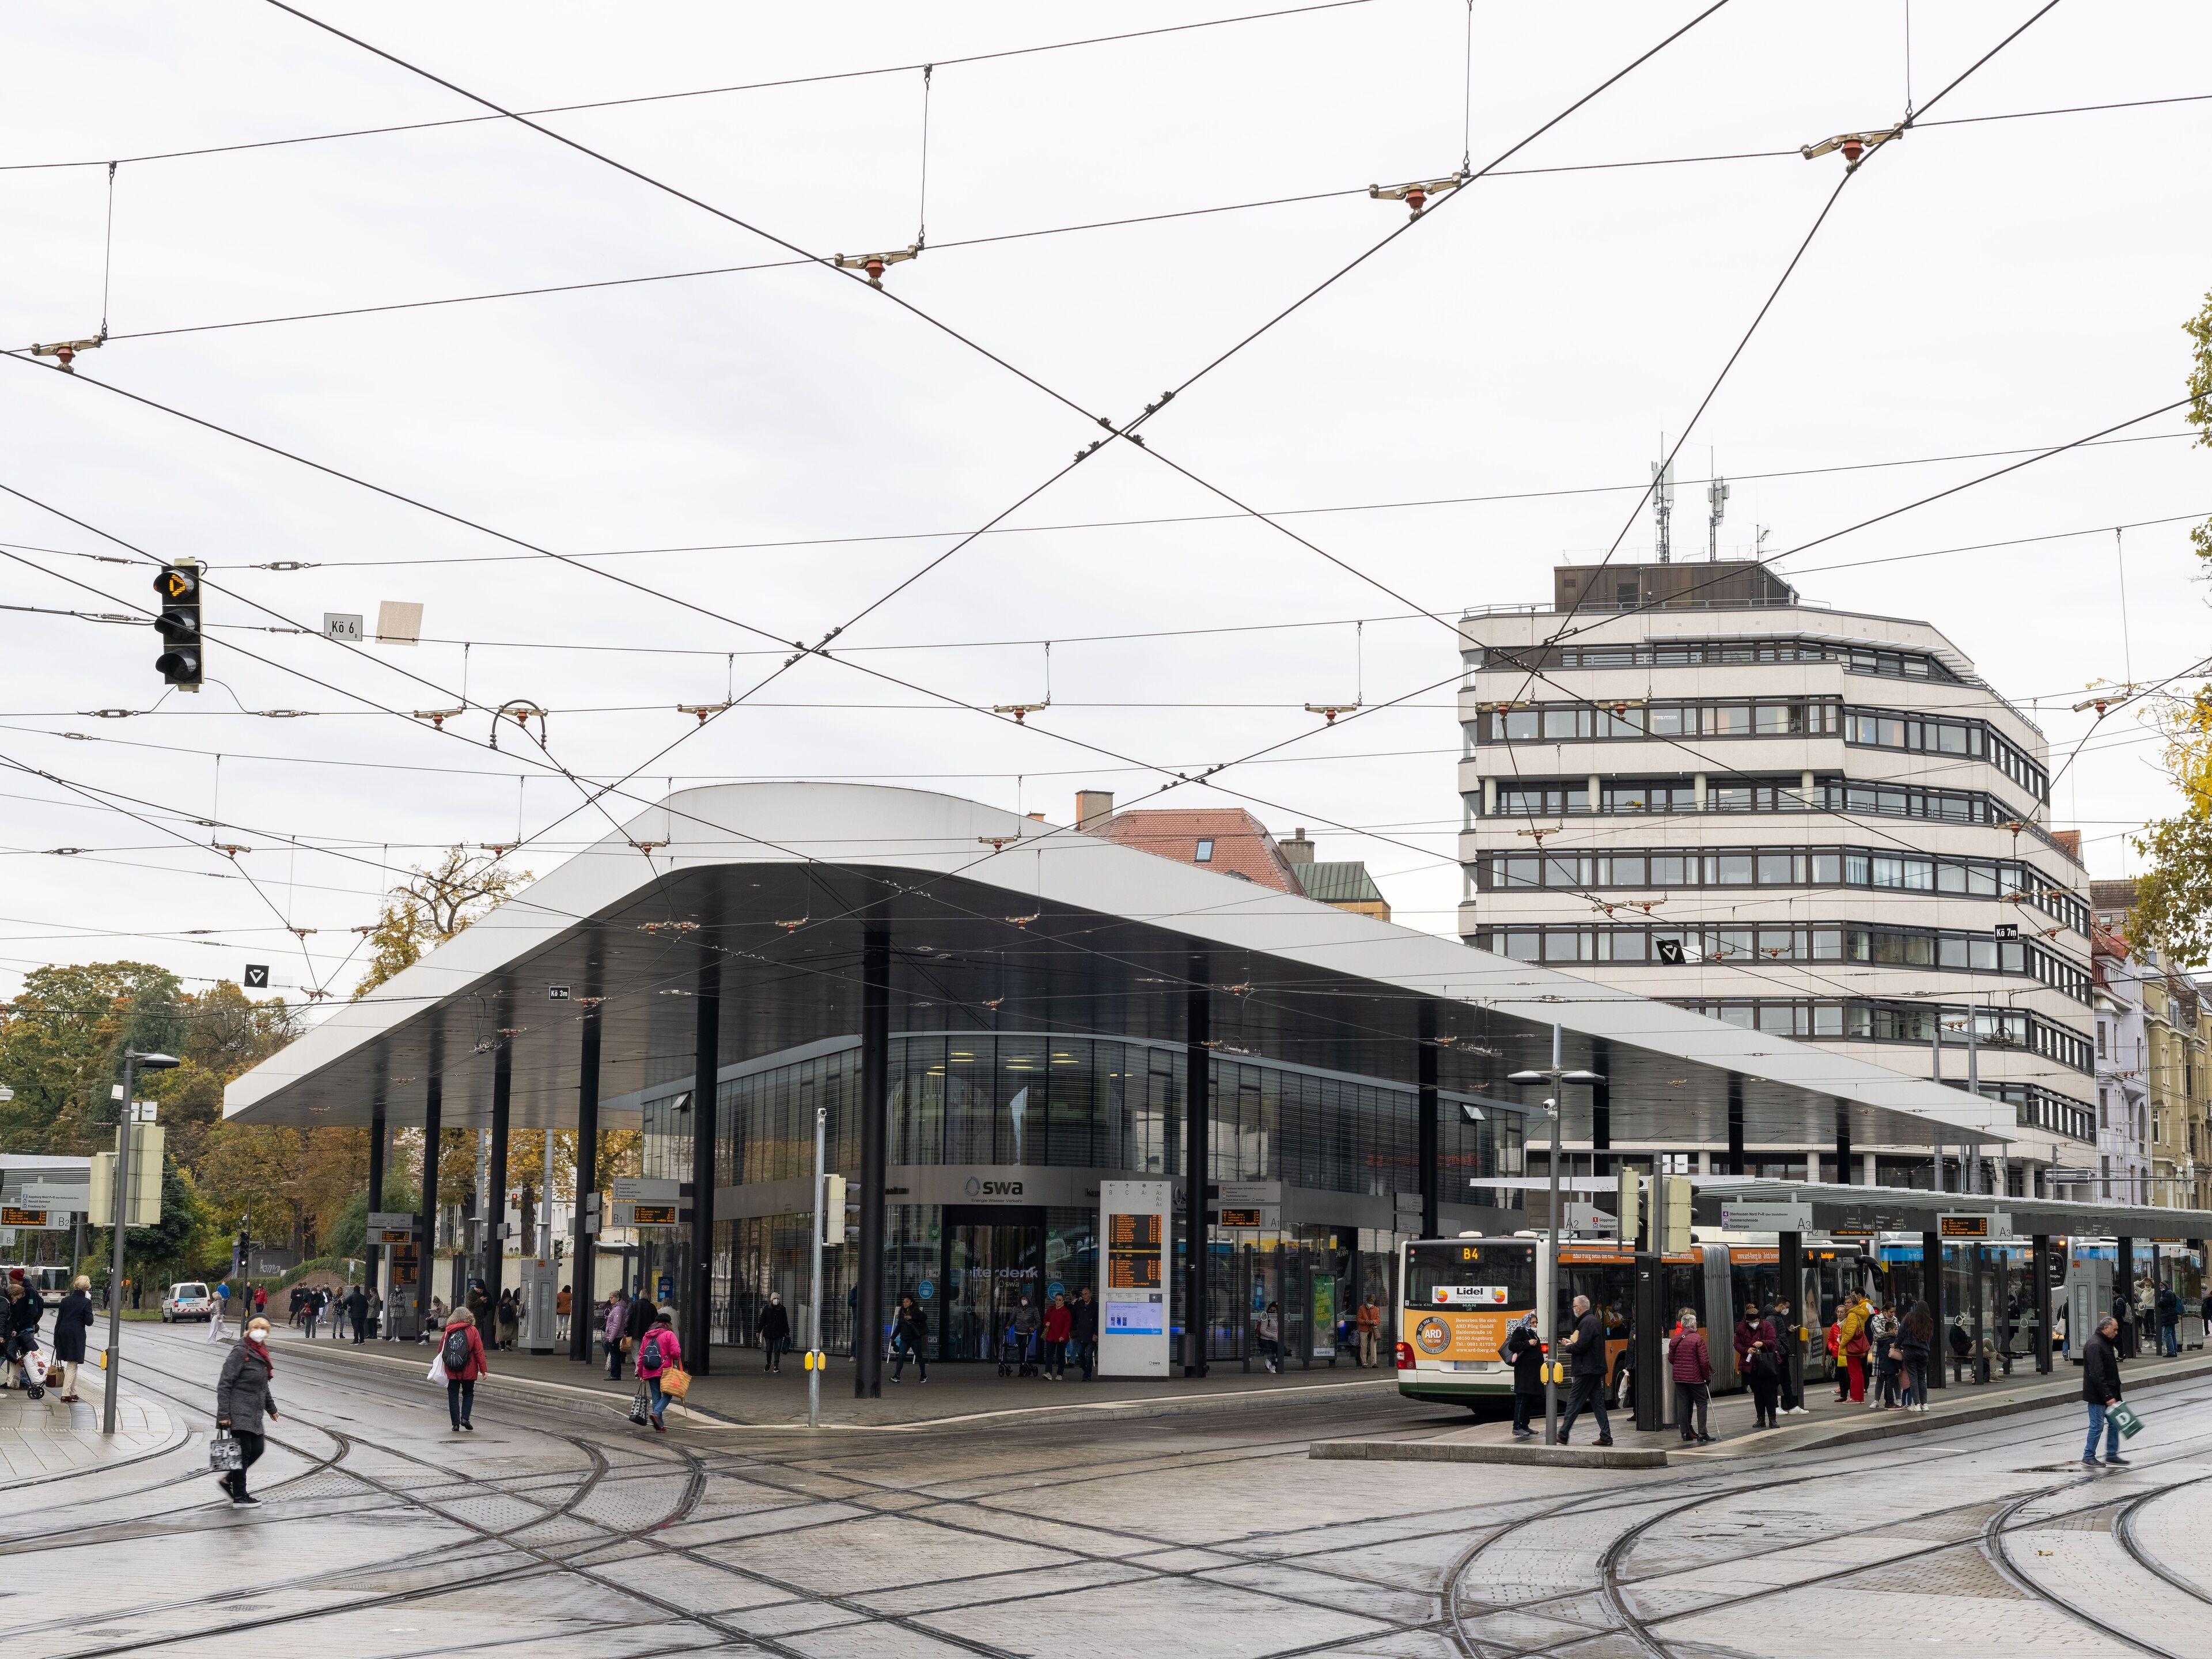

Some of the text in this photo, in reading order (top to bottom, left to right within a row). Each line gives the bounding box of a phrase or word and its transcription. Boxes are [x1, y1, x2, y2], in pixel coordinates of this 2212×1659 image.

[332, 620, 354, 634] Kö 6
[1997, 928, 2016, 937] Kö 7m
[983, 1181, 1023, 1195] swa
[58, 1217, 70, 1227] B2
[613, 1214, 622, 1223] B1
[1271, 1218, 1279, 1227] A1
[1566, 1217, 1579, 1229] A2
[1797, 1217, 1811, 1230] A3
[1999, 1227, 2011, 1237] A3
[1463, 1248, 1478, 1259] B4
[1737, 1252, 1762, 1260] www.ard-foerg.de
[1809, 1250, 1813, 1260] B4
[1425, 1329, 1442, 1338] ARD
[2115, 1412, 2131, 1426] D
